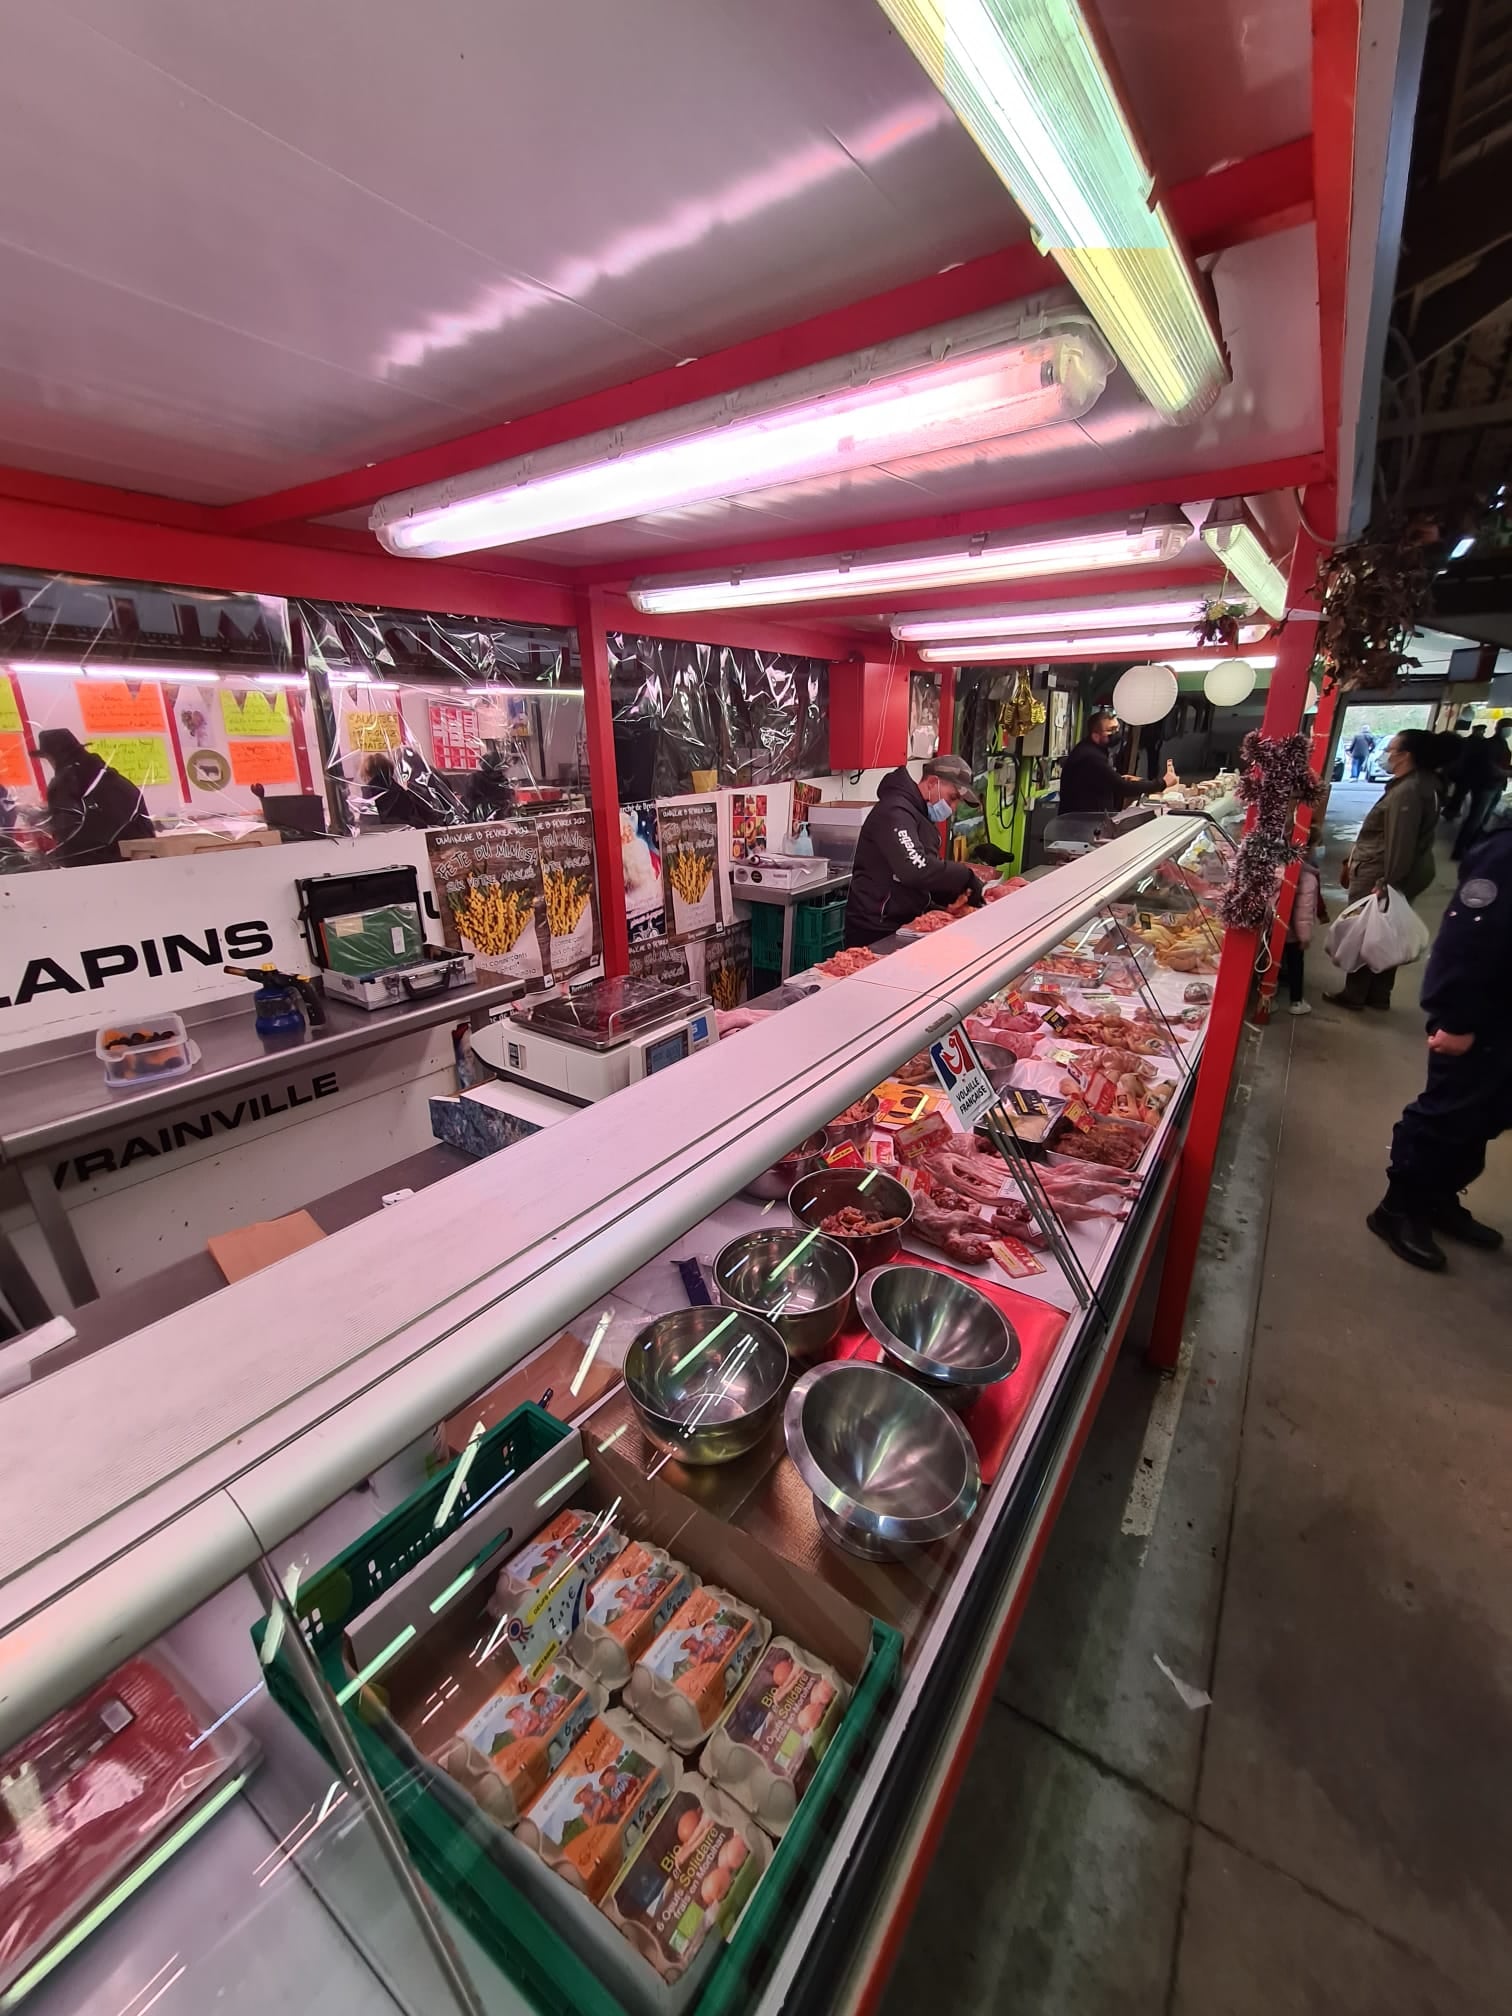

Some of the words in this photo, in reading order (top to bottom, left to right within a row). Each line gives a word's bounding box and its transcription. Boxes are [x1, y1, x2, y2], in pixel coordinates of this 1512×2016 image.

[474, 841, 492, 861] DU
[496, 840, 538, 866] MIMOSA
[956, 1077, 981, 1101] VOLAILLE
[960, 1085, 988, 1114] FRANÇAISE
[761, 1687, 777, 1709] Bio
[778, 1673, 809, 1719] Solidaire
[761, 1743, 770, 1752] 6
[660, 1844, 682, 1874] Bio
[679, 1827, 719, 1888] Solidaire
[673, 1894, 692, 1920] frais
[689, 1879, 700, 1895] en
[695, 1832, 727, 1880] Morbihan
[656, 1920, 665, 1931] 6
